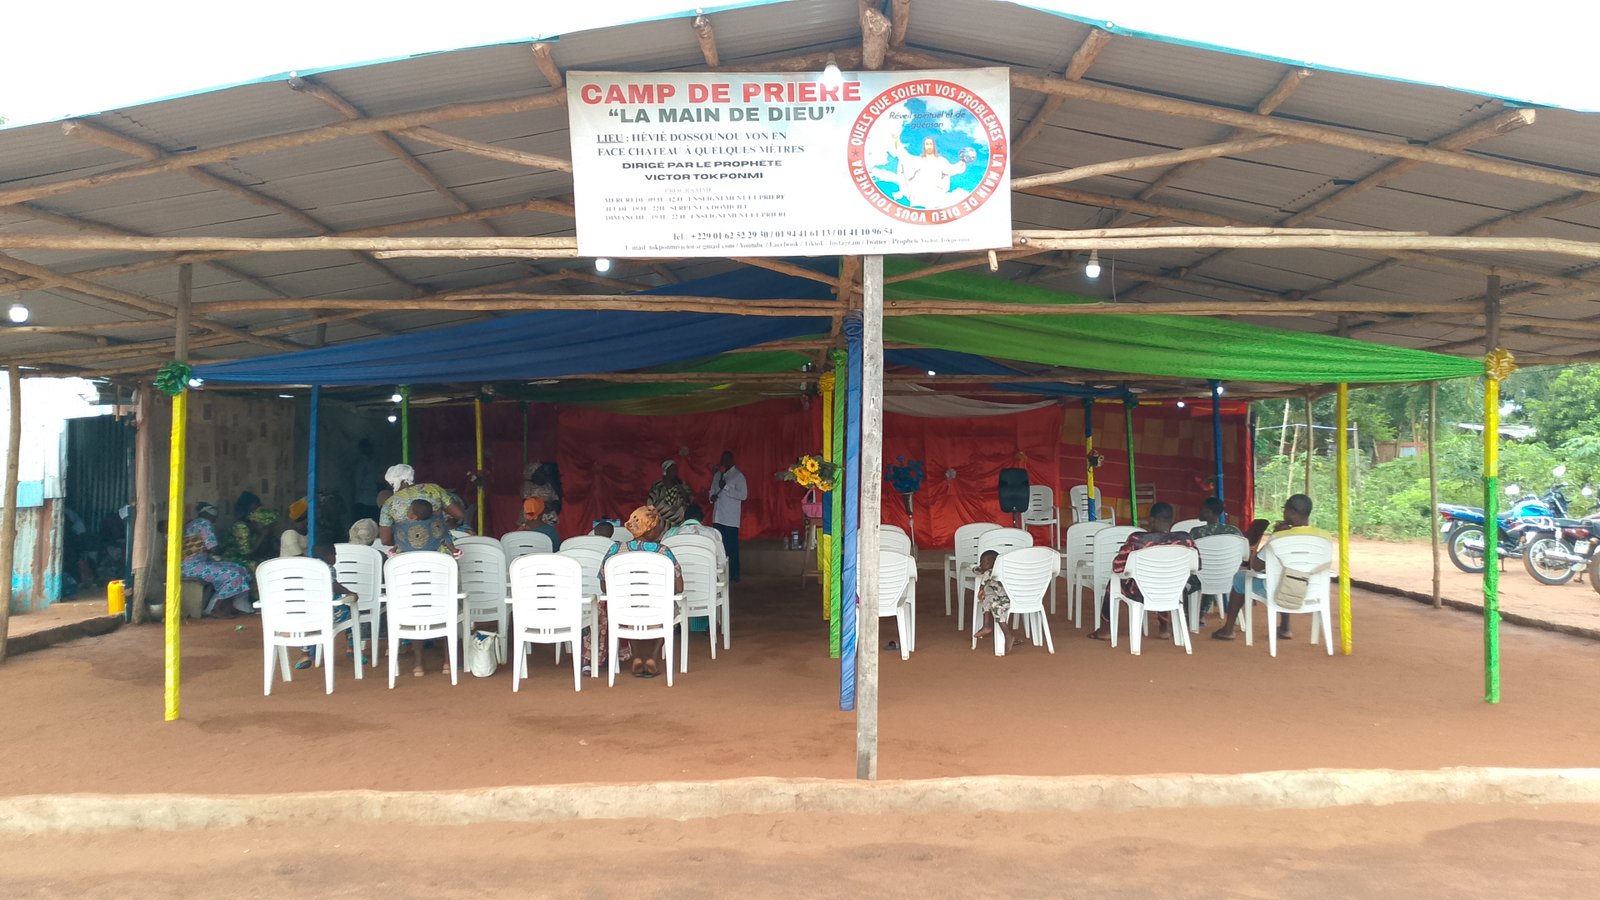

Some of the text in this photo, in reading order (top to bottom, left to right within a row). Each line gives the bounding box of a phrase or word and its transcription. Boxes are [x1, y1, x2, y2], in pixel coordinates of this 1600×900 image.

[580, 82, 861, 104] CAMP DE PRIERE
[658, 107, 720, 122] MAIN
[729, 107, 760, 122] DE
[851, 113, 872, 146] QUELS
[869, 95, 892, 114] QUE
[890, 83, 932, 102] SOIENT
[935, 83, 957, 97] VOS
[597, 133, 624, 143] LIEU
[670, 132, 741, 142] DOSSOUNOU
[745, 132, 769, 141] VON
[772, 131, 787, 140] EN
[598, 148, 626, 156] FACE
[628, 147, 681, 156] CHATEAU
[695, 146, 756, 156] QUELQUES
[667, 161, 694, 169] PAR
[645, 172, 763, 181] VICTOR TOKPONMI
[851, 154, 1004, 223] LA MAIN DE DIEU VOUS TOUCHERA
